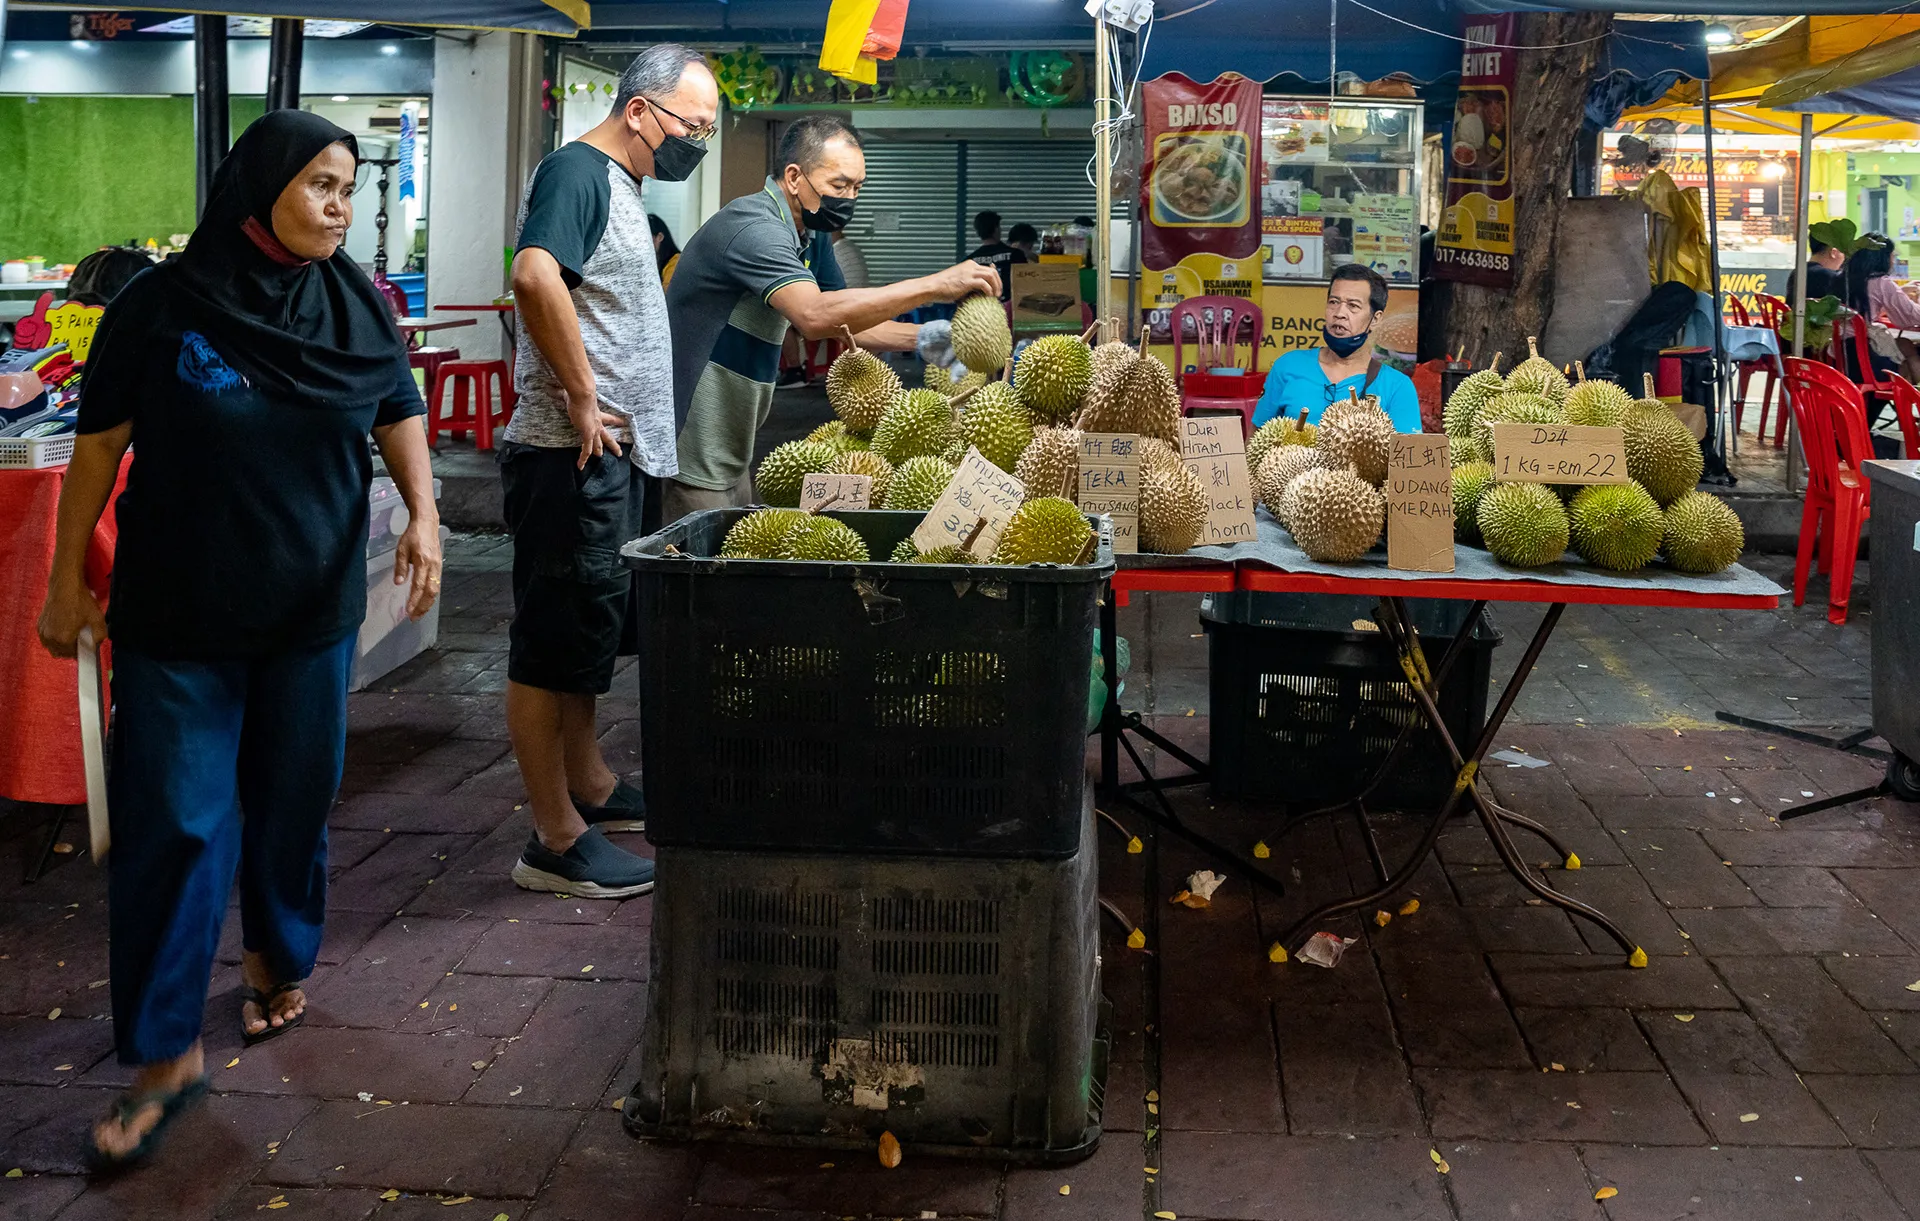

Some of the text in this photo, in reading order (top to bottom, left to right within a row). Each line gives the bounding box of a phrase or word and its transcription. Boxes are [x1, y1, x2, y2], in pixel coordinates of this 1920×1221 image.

[88, 12, 136, 37] Tiger
[1462, 52, 1502, 77] ENYET
[1168, 102, 1237, 127] BAKSO
[1713, 160, 1758, 174] BAAR
[1286, 219, 1322, 227] BINTANG
[1436, 248, 1509, 271] 017-6636858
[1162, 285, 1178, 294] PPZ
[1203, 279, 1253, 289] USAHAWAN
[1204, 288, 1253, 298] BAITULMAL
[54, 315, 63, 329] 3
[77, 337, 88, 347] 15
[1531, 428, 1568, 446] D24
[1182, 440, 1222, 455] HITAM
[1503, 455, 1510, 475] 1
[1518, 456, 1540, 475] KG
[968, 455, 1025, 503] MUSANG
[1082, 467, 1128, 490] TEKA
[1394, 479, 1450, 497] UDANG
[1083, 499, 1138, 513] MUSANG
[1204, 495, 1246, 512] lack
[1390, 501, 1452, 519] MERAH
